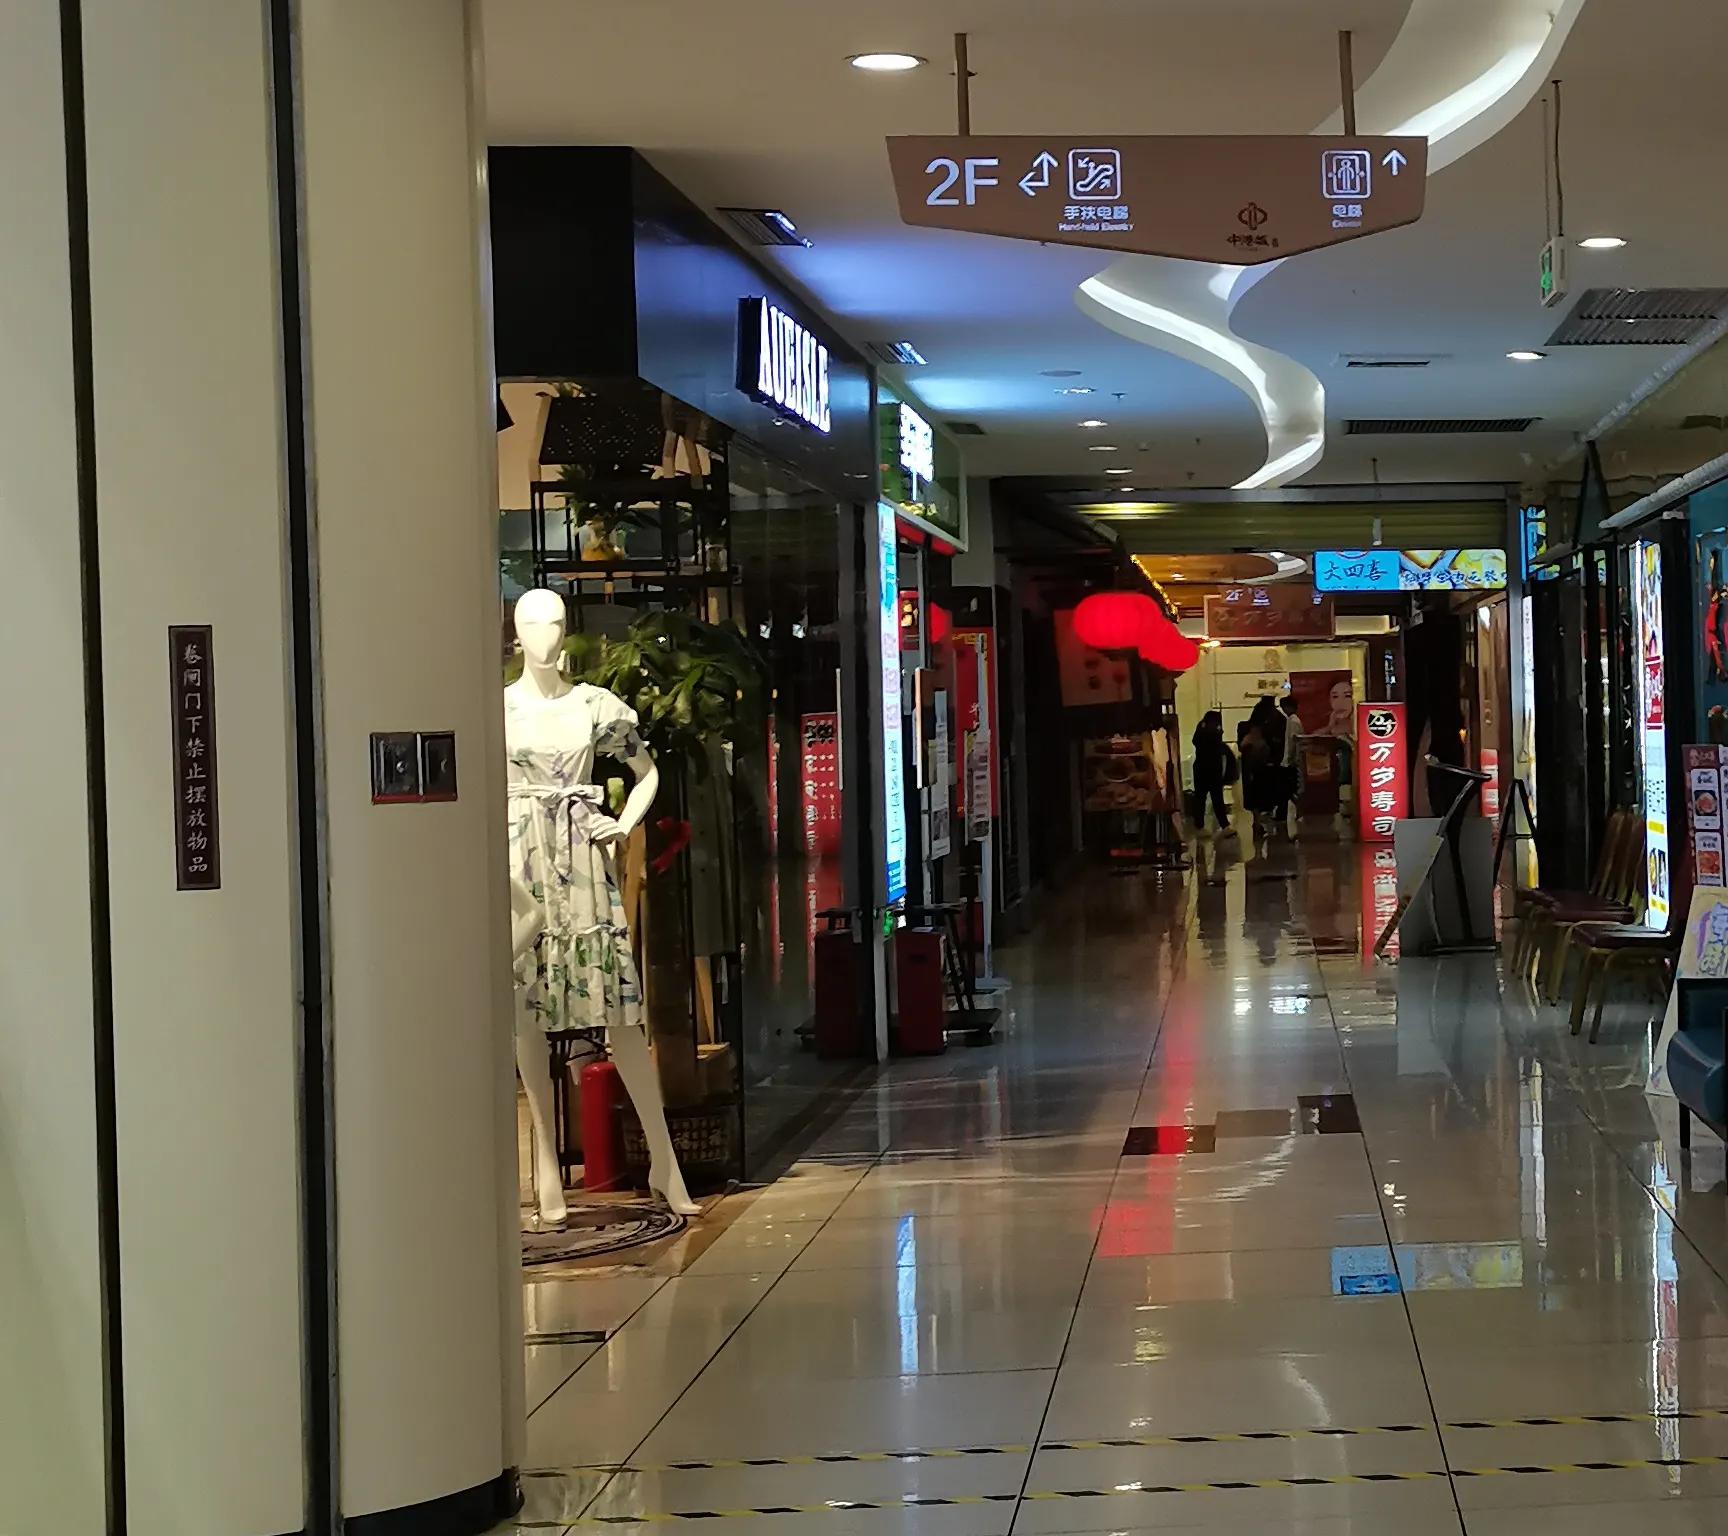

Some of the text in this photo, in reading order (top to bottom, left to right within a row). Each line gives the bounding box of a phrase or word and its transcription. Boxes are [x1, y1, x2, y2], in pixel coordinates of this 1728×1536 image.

[925, 158, 999, 205] 2F
[1064, 205, 1129, 220] 手扶电梯
[1332, 204, 1363, 217] 电梯
[1369, 742, 1397, 836] 万岁寿司
